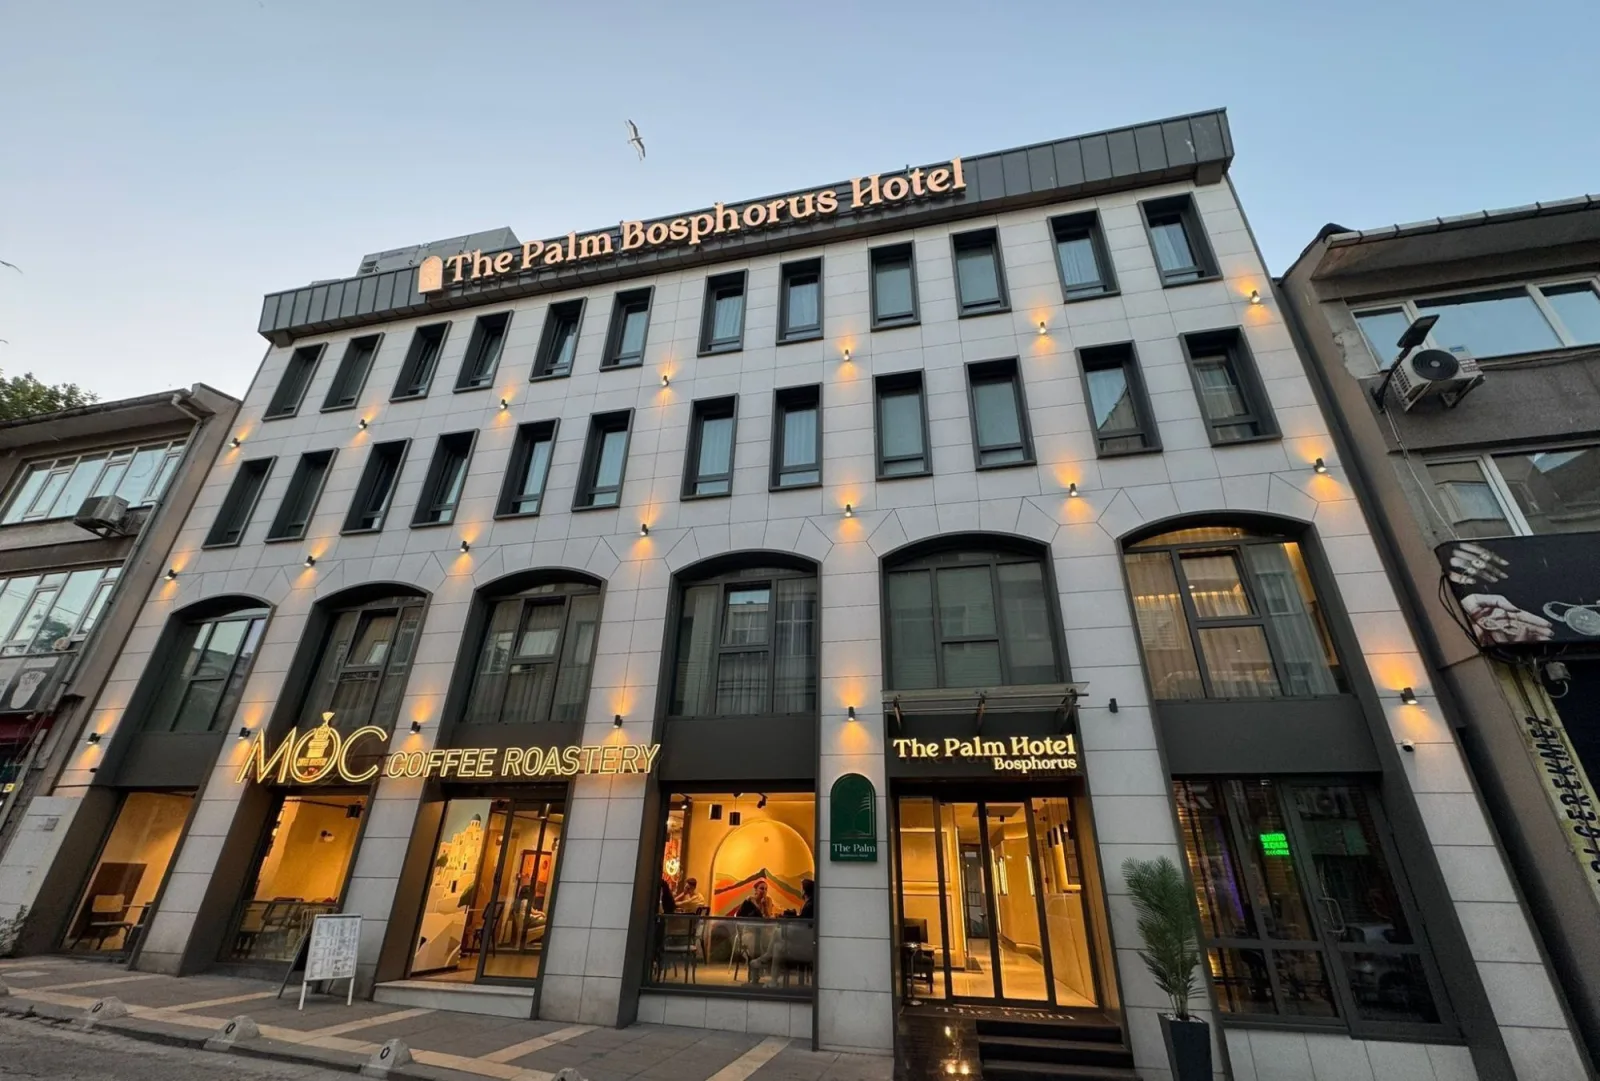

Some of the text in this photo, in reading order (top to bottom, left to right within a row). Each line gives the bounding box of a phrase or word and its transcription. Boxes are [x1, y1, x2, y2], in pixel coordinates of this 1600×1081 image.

[446, 157, 966, 283] The Palm Bosphorus Hotel
[236, 726, 662, 783] MOC COFFEE ROASTERY
[893, 734, 1077, 758] The Palm Hotel
[994, 757, 1077, 773] Bosphorus
[832, 843, 876, 853] The Palm
